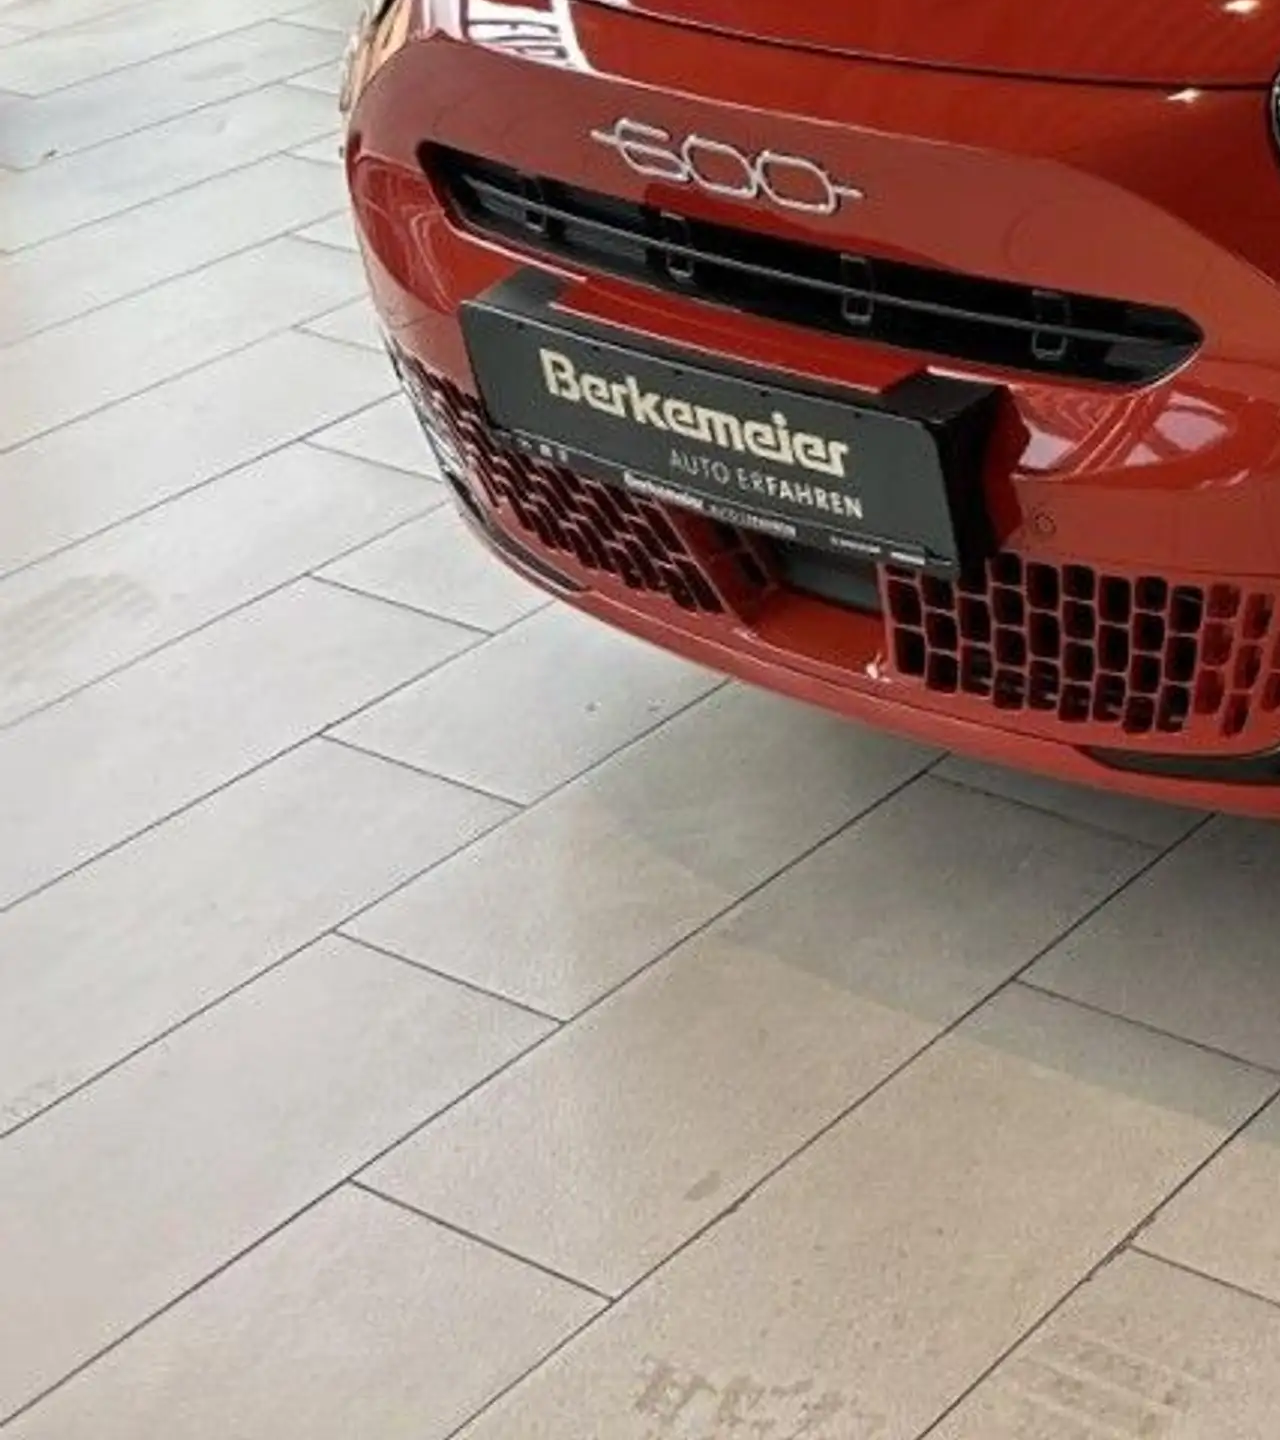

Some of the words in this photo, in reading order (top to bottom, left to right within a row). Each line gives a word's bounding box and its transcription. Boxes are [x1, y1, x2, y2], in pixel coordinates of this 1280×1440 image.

[590, 117, 862, 215] 600
[539, 347, 849, 478] Berkemeier
[669, 449, 731, 485] AUTO
[738, 467, 863, 519] ERFAHREN
